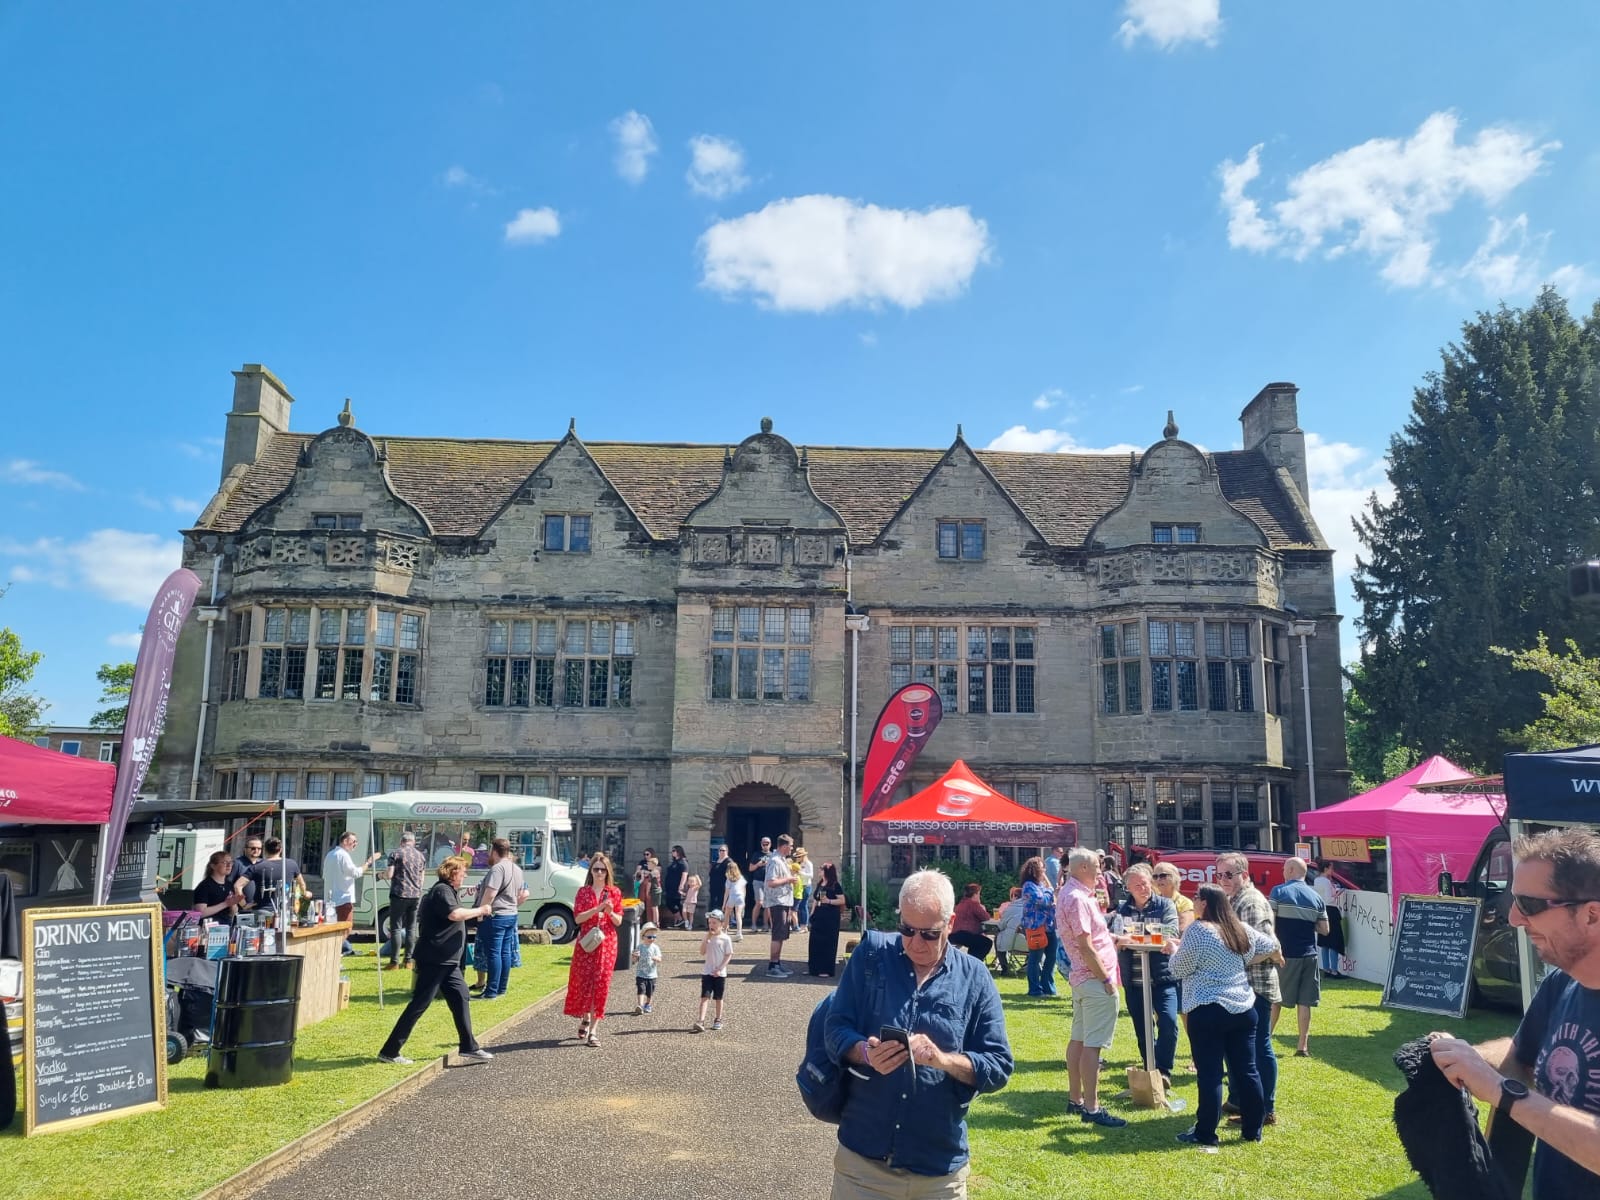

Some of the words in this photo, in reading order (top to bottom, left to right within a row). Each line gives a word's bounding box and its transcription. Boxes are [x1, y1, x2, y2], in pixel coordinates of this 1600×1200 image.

[888, 821, 939, 831] ESPRESSO
[941, 822, 982, 831] COFFEE
[984, 822, 1023, 832] SERVED
[1025, 823, 1054, 832] HERE
[1331, 840, 1359, 857] CIDER
[1350, 894, 1385, 935] Apples
[34, 922, 101, 948] DRINKS
[107, 919, 151, 942] MENU
[35, 948, 50, 959] Gin
[35, 1036, 56, 1047] Rum
[1551, 1022, 1580, 1045] WITH
[1580, 1029, 1600, 1062] THE
[35, 1060, 67, 1075] Vodka
[40, 1091, 68, 1110] Single
[70, 1085, 89, 1103] £6
[97, 1079, 127, 1094] Double
